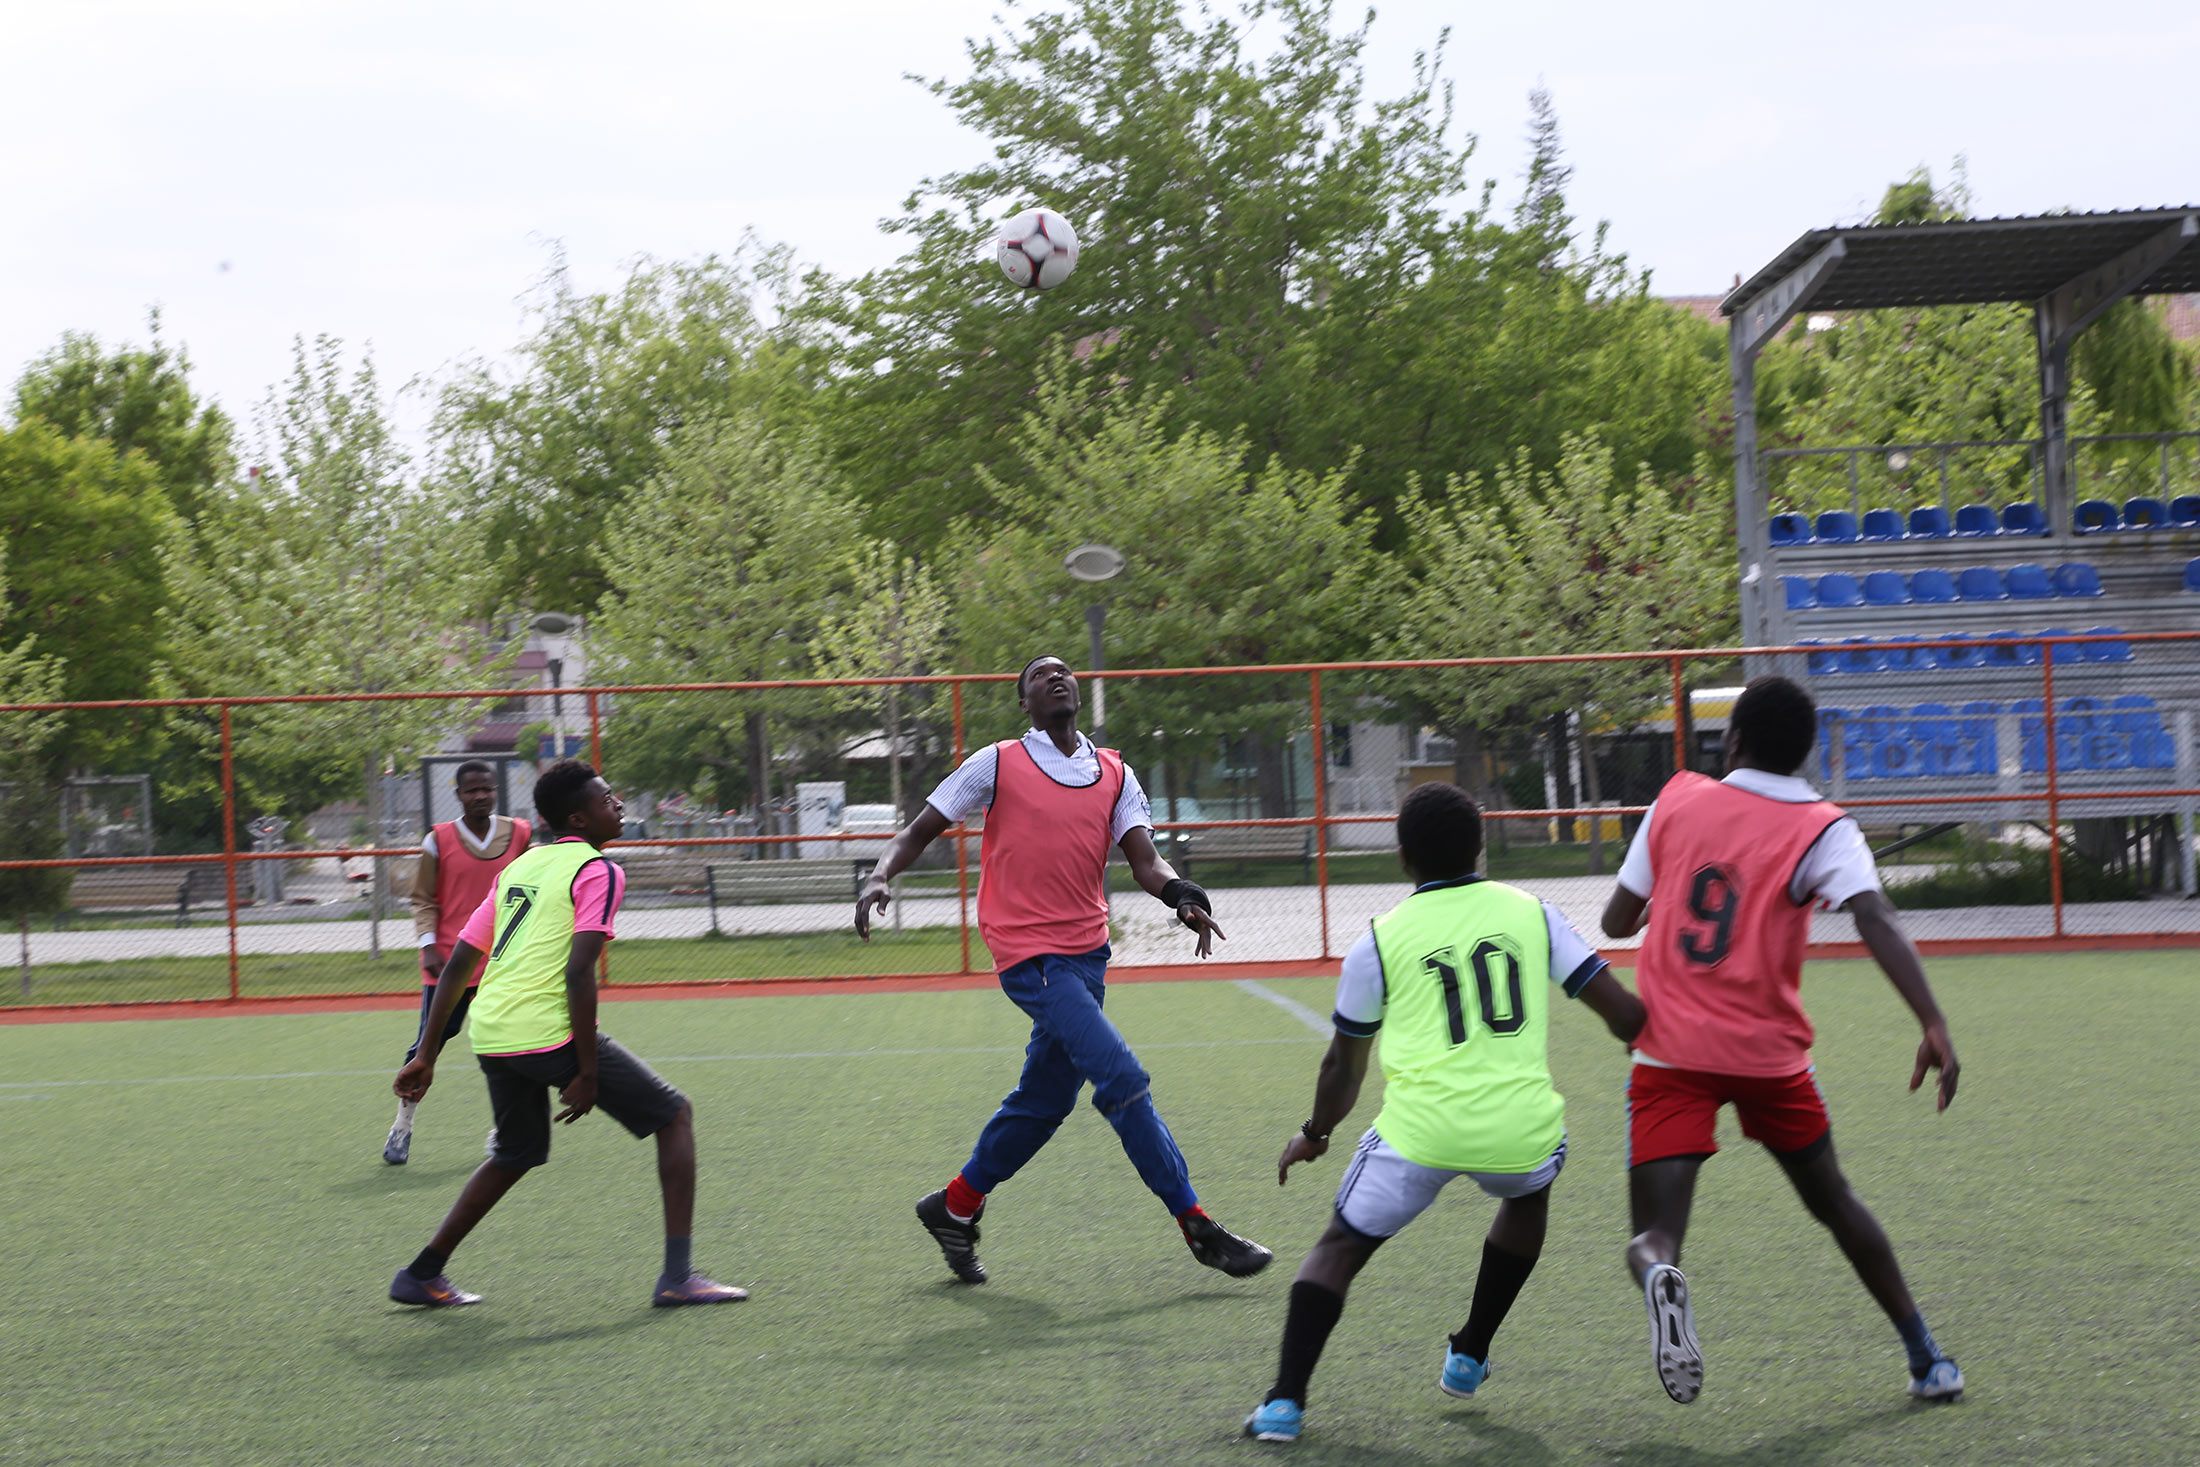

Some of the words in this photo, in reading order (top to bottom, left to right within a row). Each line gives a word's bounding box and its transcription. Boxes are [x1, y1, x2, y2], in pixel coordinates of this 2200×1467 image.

[488, 884, 540, 961] 7
[1678, 862, 1740, 970] 9
[1419, 933, 1529, 1050] 10
